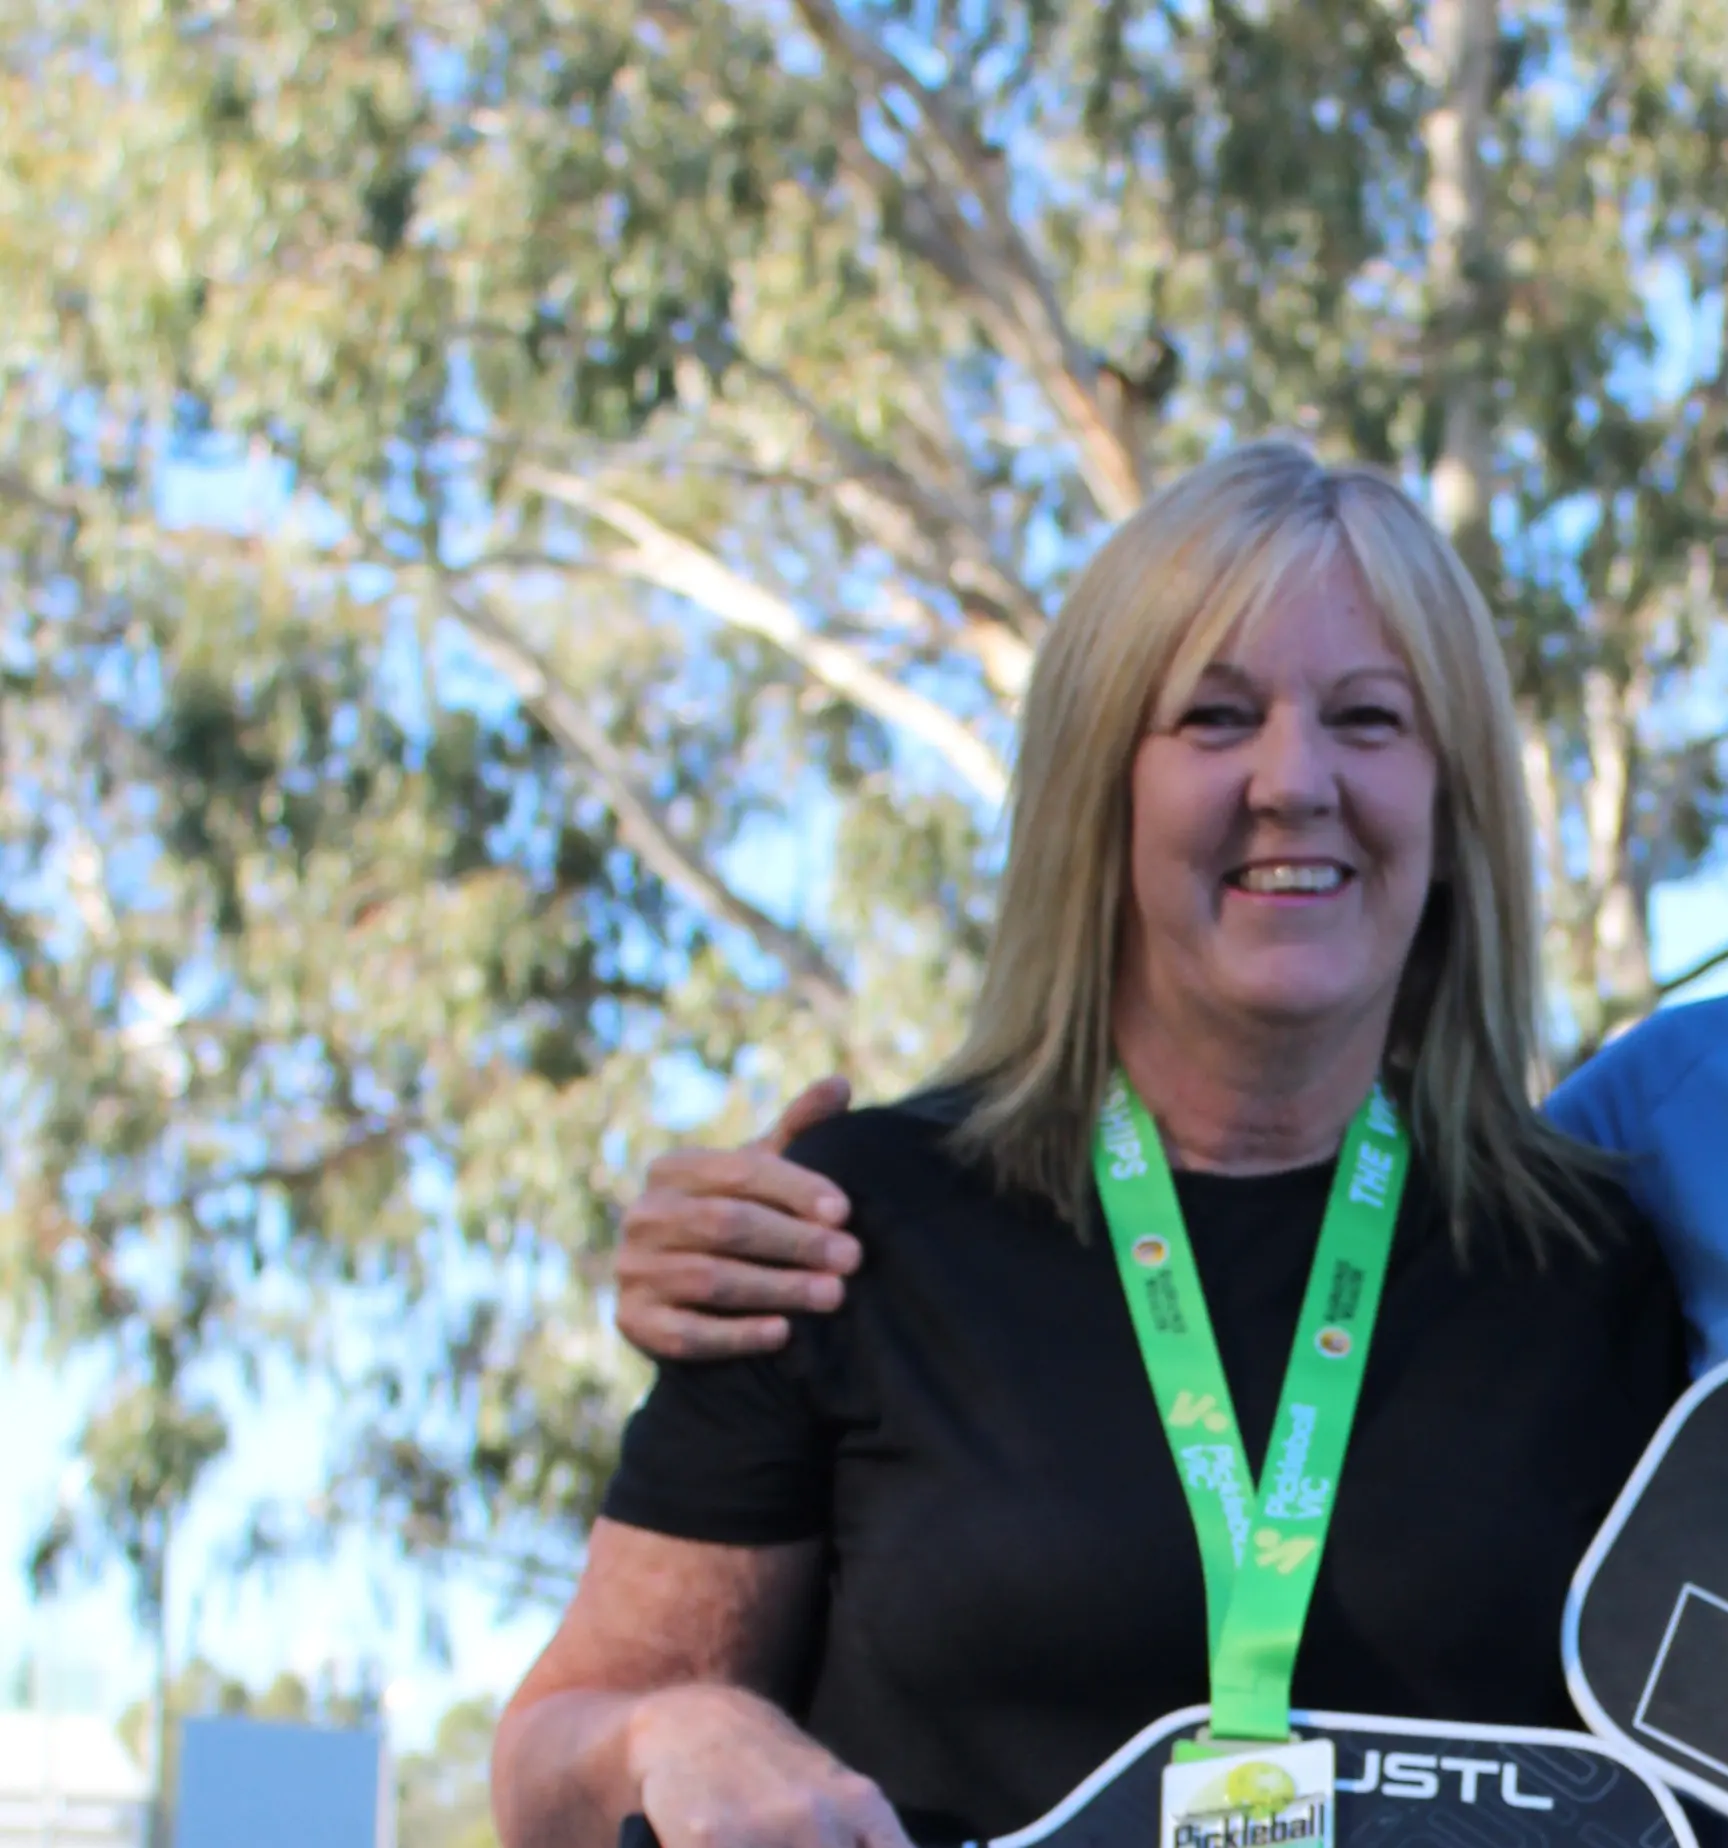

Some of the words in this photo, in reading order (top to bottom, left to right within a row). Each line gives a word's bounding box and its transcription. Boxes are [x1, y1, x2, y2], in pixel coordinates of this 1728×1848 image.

[1350, 1140, 1393, 1209] THE
[1264, 1401, 1317, 1518] Pickleball
[1292, 1476, 1331, 1519] VIC
[1174, 1802, 1325, 1848] Pickleball
